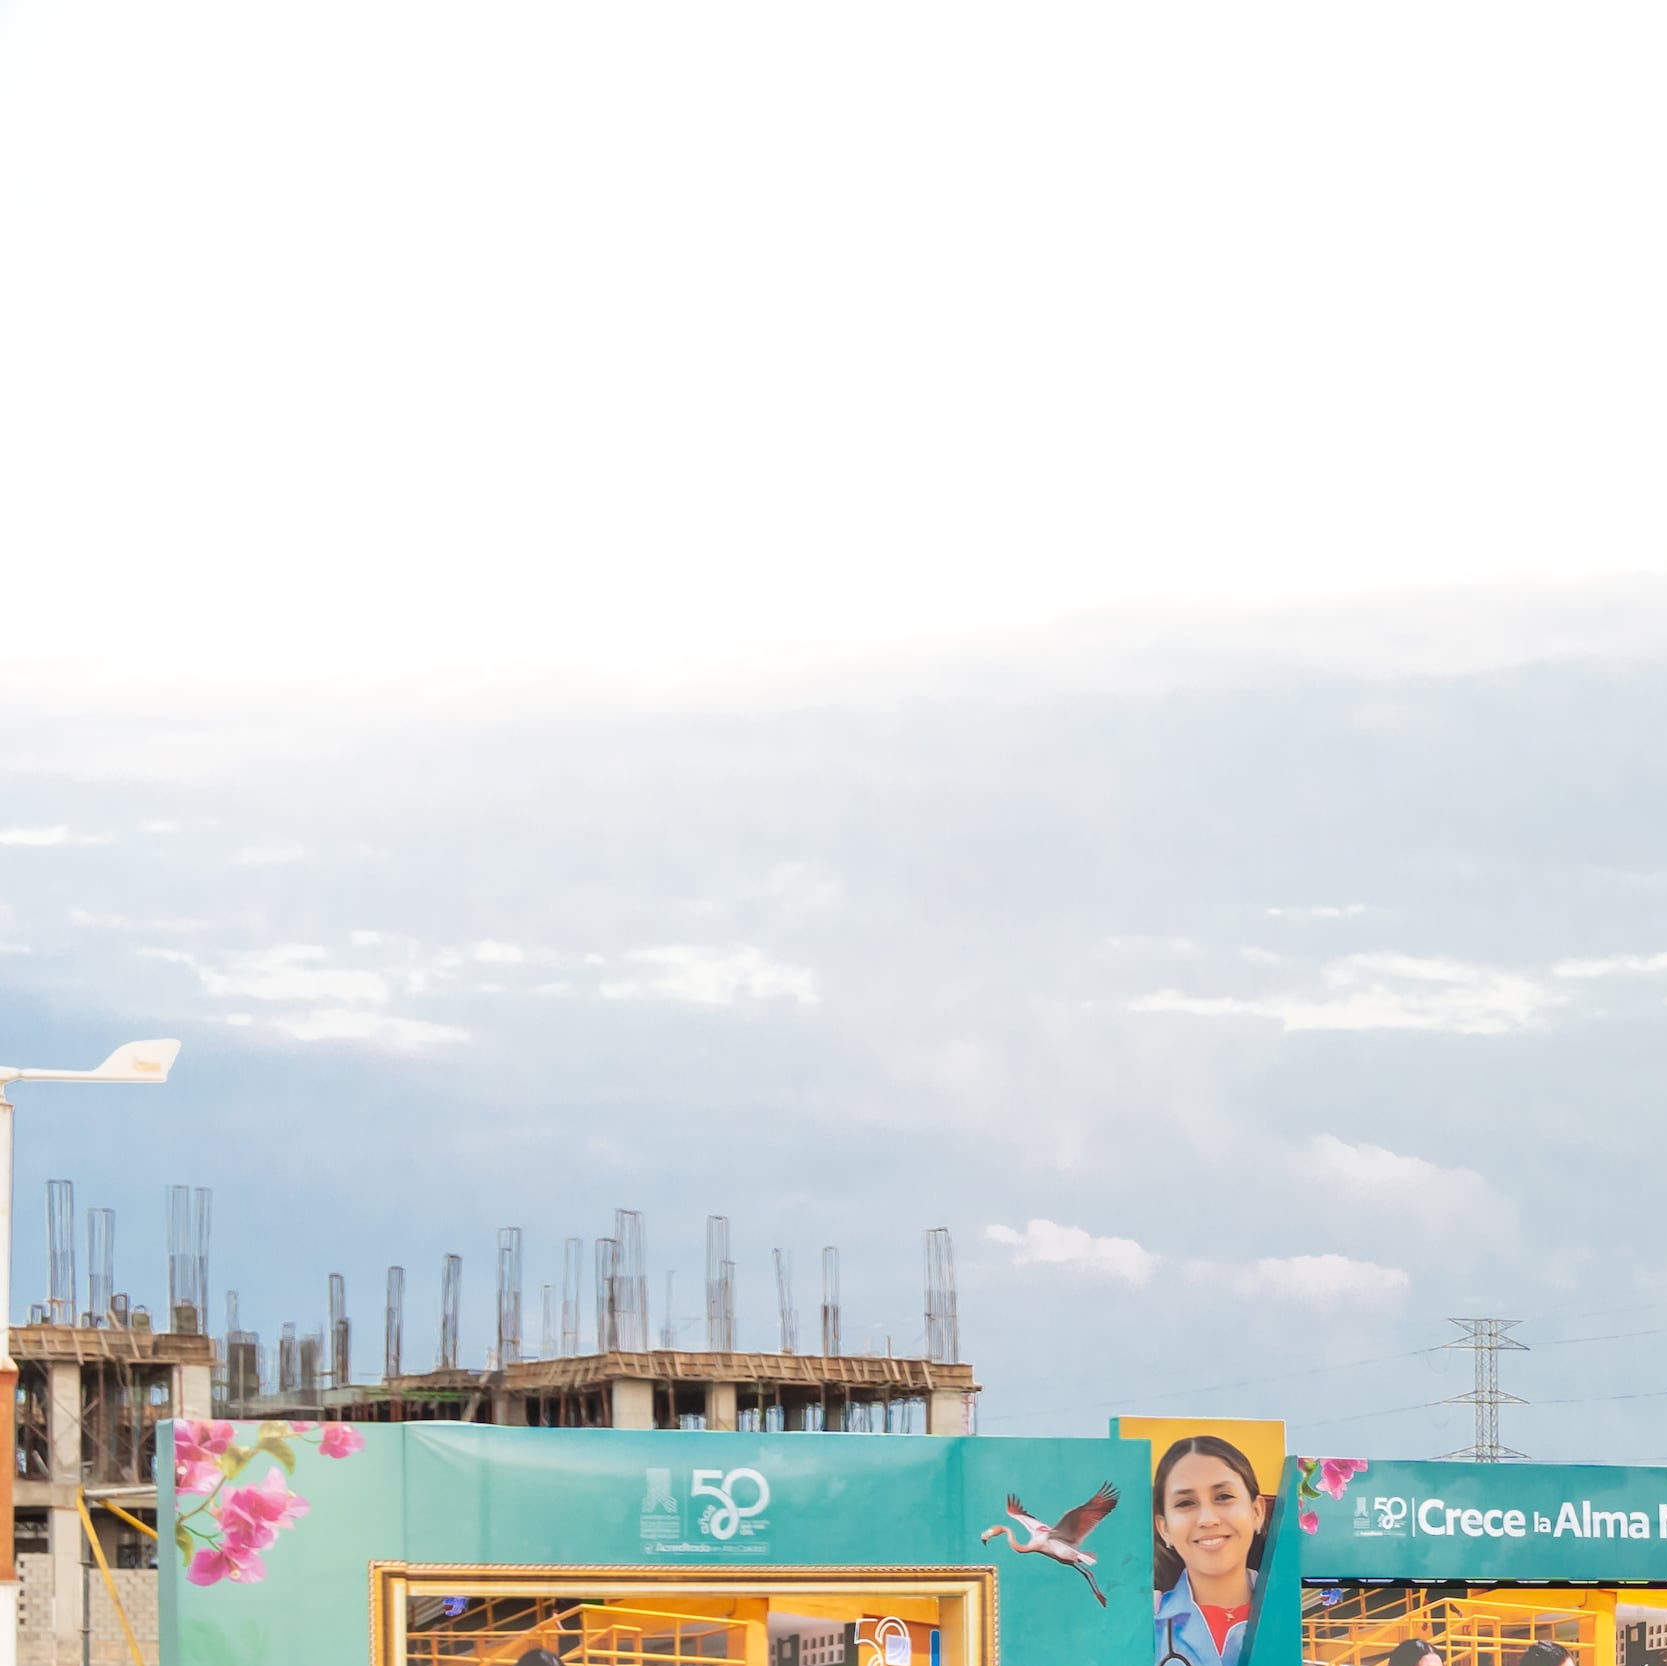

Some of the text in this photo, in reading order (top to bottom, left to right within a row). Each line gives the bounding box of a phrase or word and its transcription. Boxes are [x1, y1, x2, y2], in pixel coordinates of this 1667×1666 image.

[690, 1467, 770, 1540] 50
[1374, 1497, 1407, 1529] 50
[1417, 1498, 1526, 1537] Crece
[1533, 1511, 1552, 1533] la
[1553, 1500, 1650, 1538] Alma
